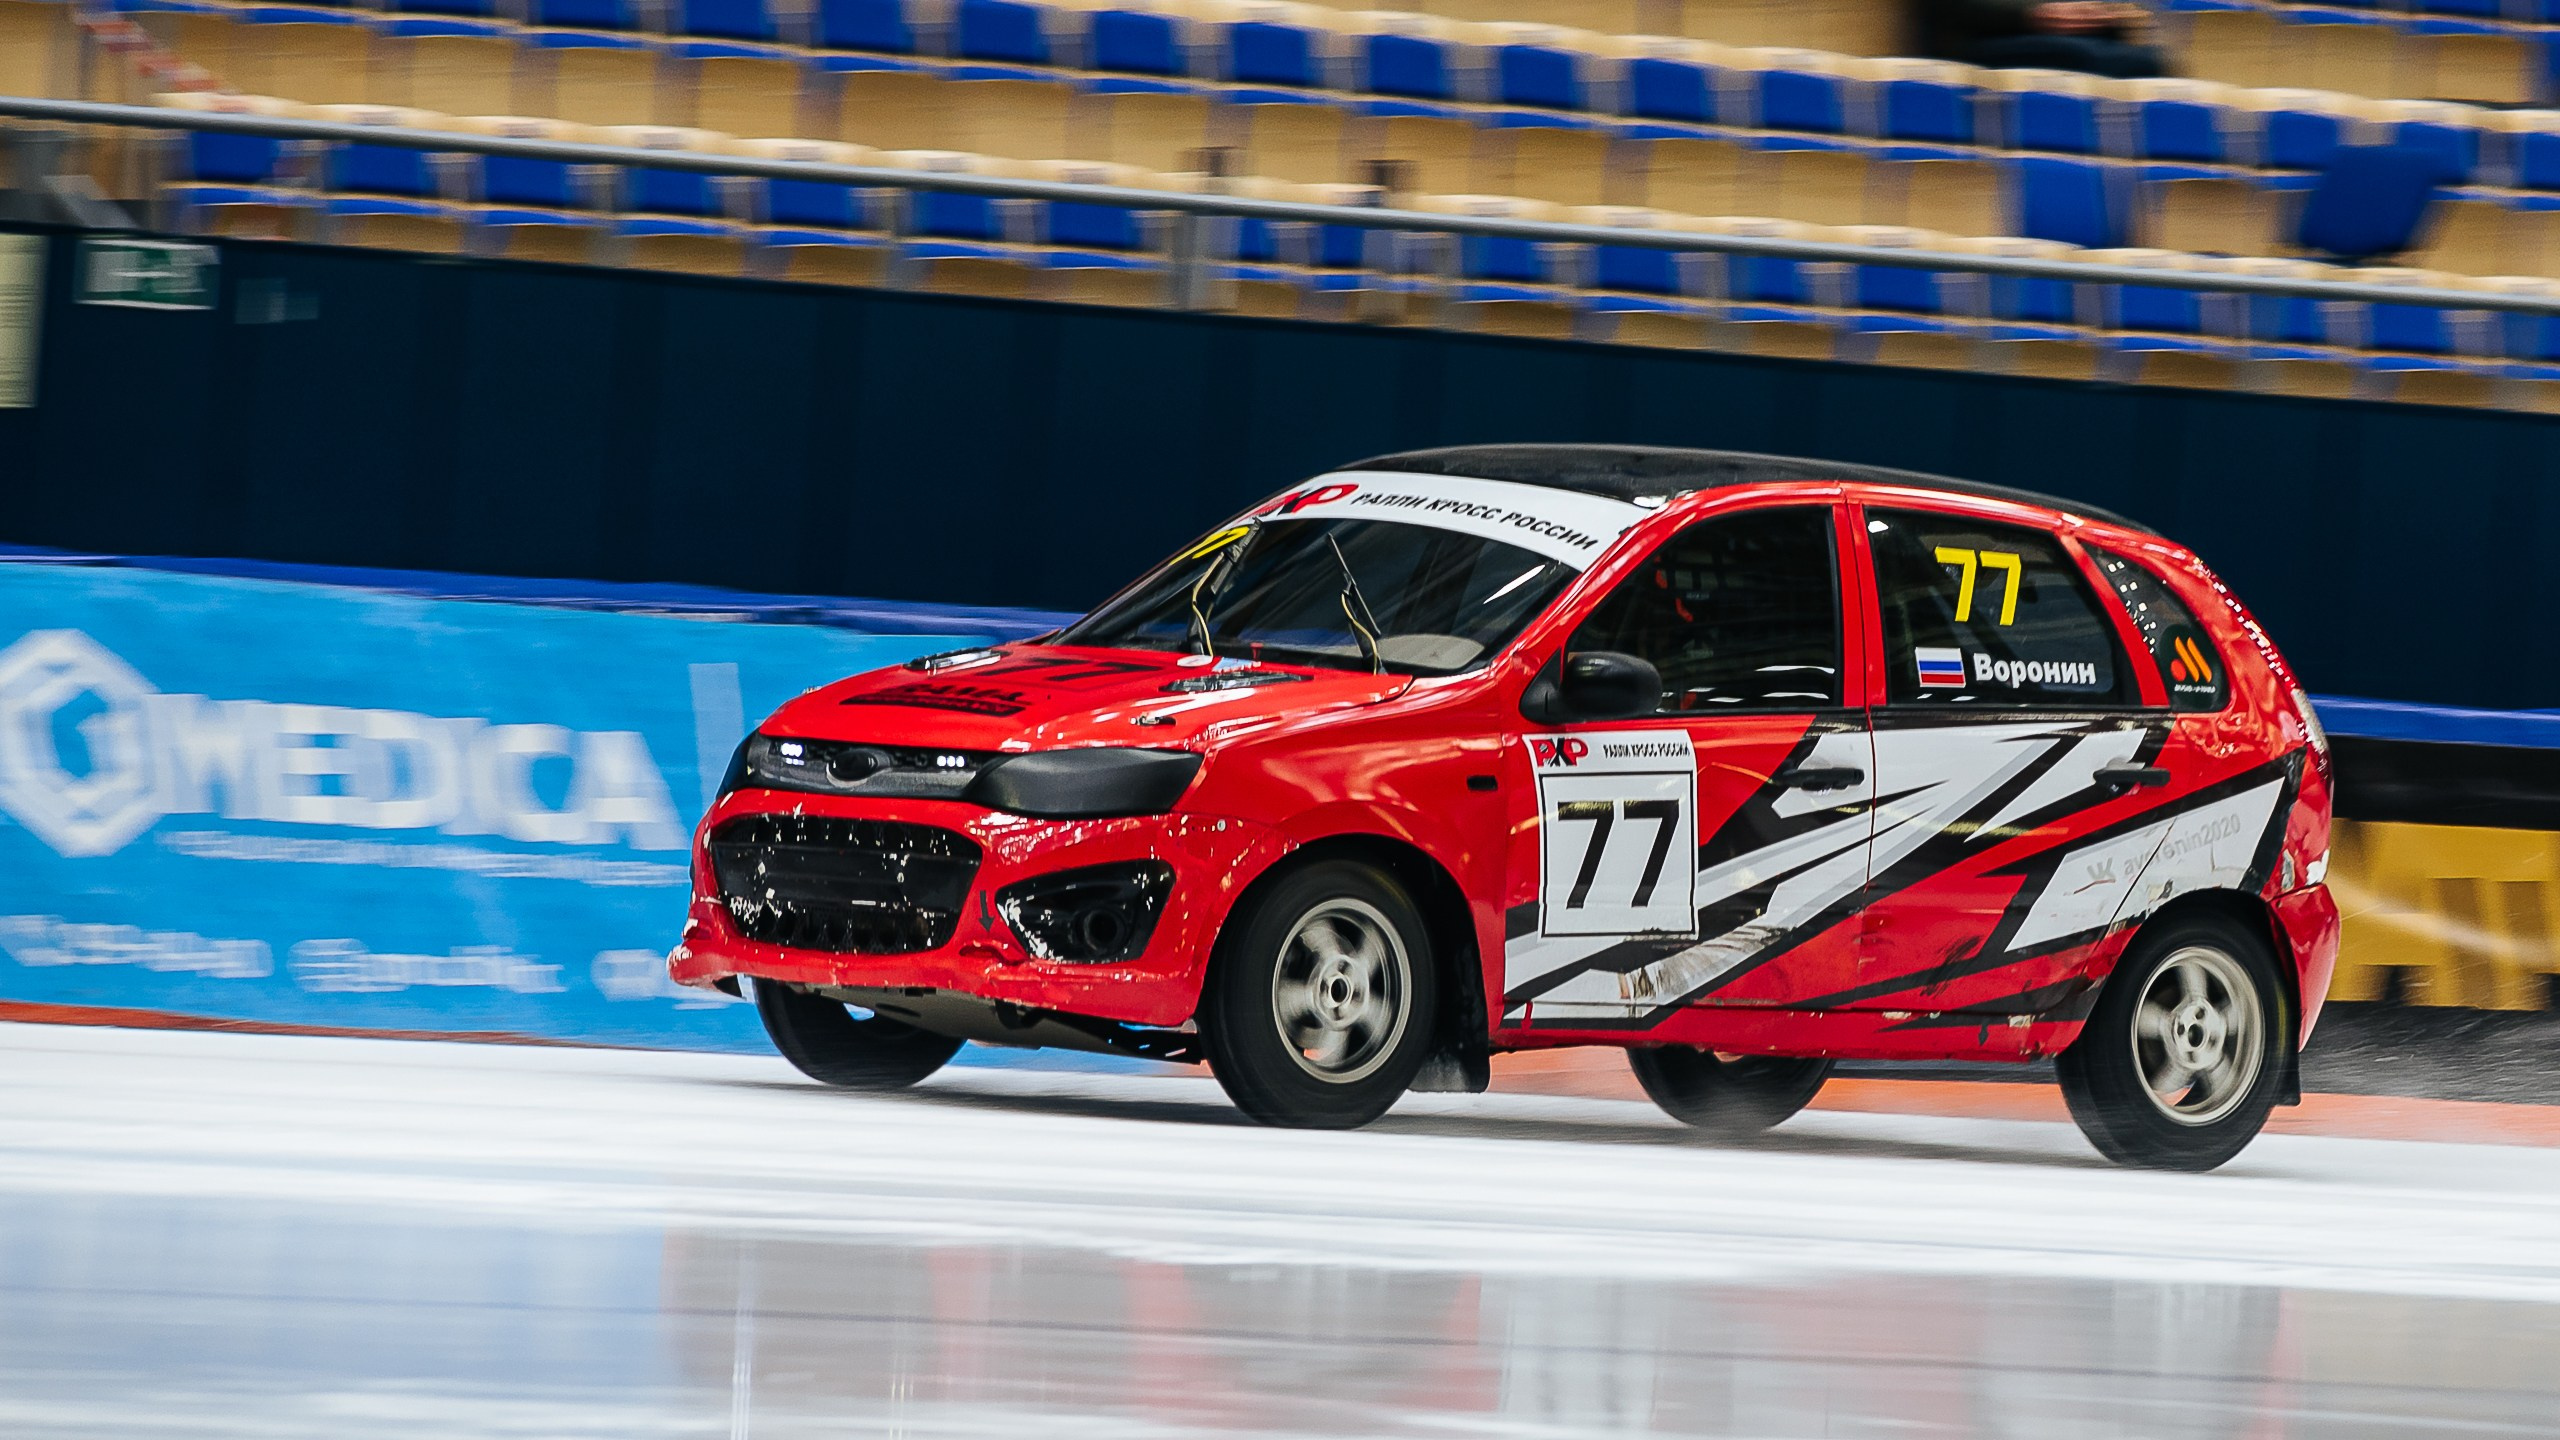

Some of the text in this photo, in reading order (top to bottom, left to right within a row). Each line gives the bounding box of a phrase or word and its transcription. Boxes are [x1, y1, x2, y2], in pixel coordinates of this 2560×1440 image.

[1425, 498, 1502, 520] КРОСС
[1500, 511, 1599, 550] РОССИИ
[1935, 546, 2022, 625] 77
[1973, 652, 2097, 689] Воронин
[1557, 799, 1680, 909] 77
